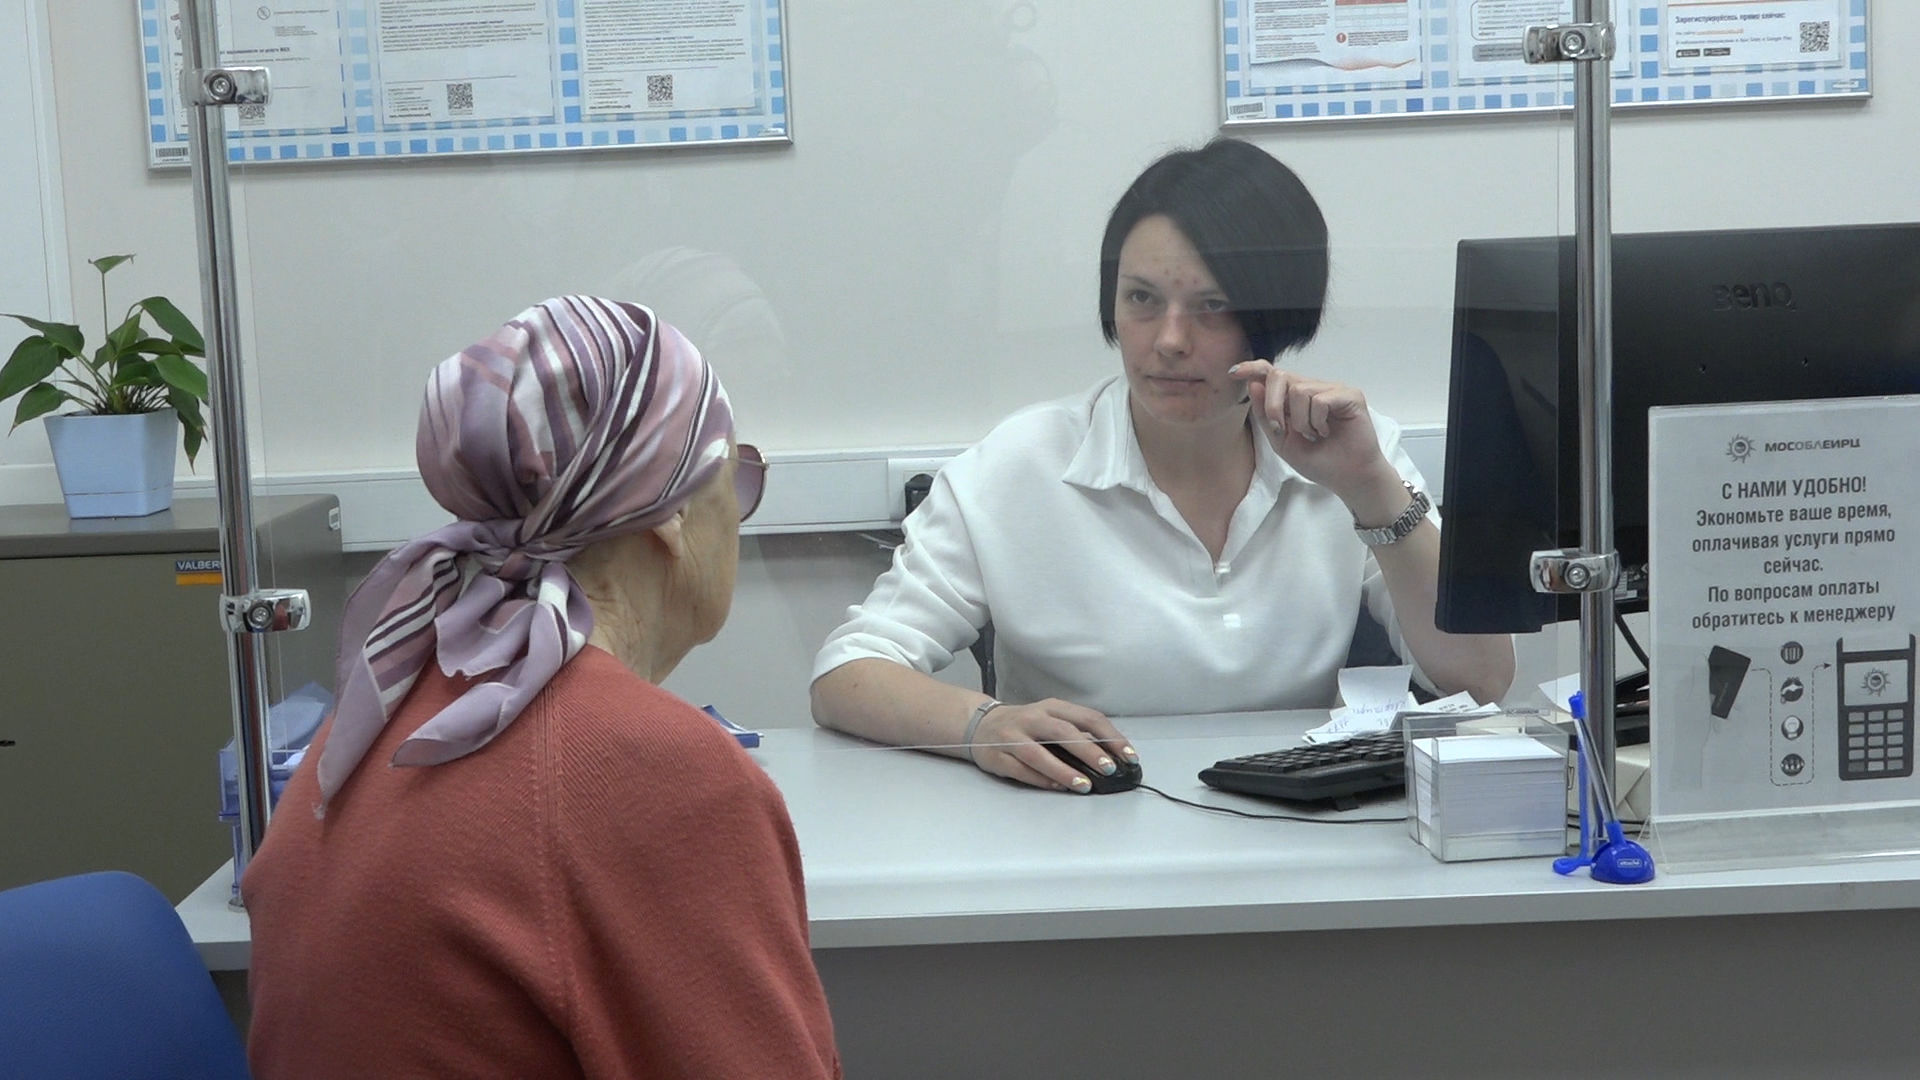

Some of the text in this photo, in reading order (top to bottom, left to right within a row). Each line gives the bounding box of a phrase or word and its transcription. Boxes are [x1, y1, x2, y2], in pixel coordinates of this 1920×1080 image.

[1764, 438, 1861, 453] МОСОБЛЕИРЦ
[1721, 475, 1867, 500] С НАМИ УДОБНО!
[1696, 503, 1892, 527] Экономьте ваше время,
[1692, 528, 1896, 553] оплачивая услуги прямо
[1763, 556, 1824, 575] сейчас.
[1708, 580, 1880, 603] По вопросам оплаты
[1691, 604, 1896, 632] обратитесь к менеджеру
